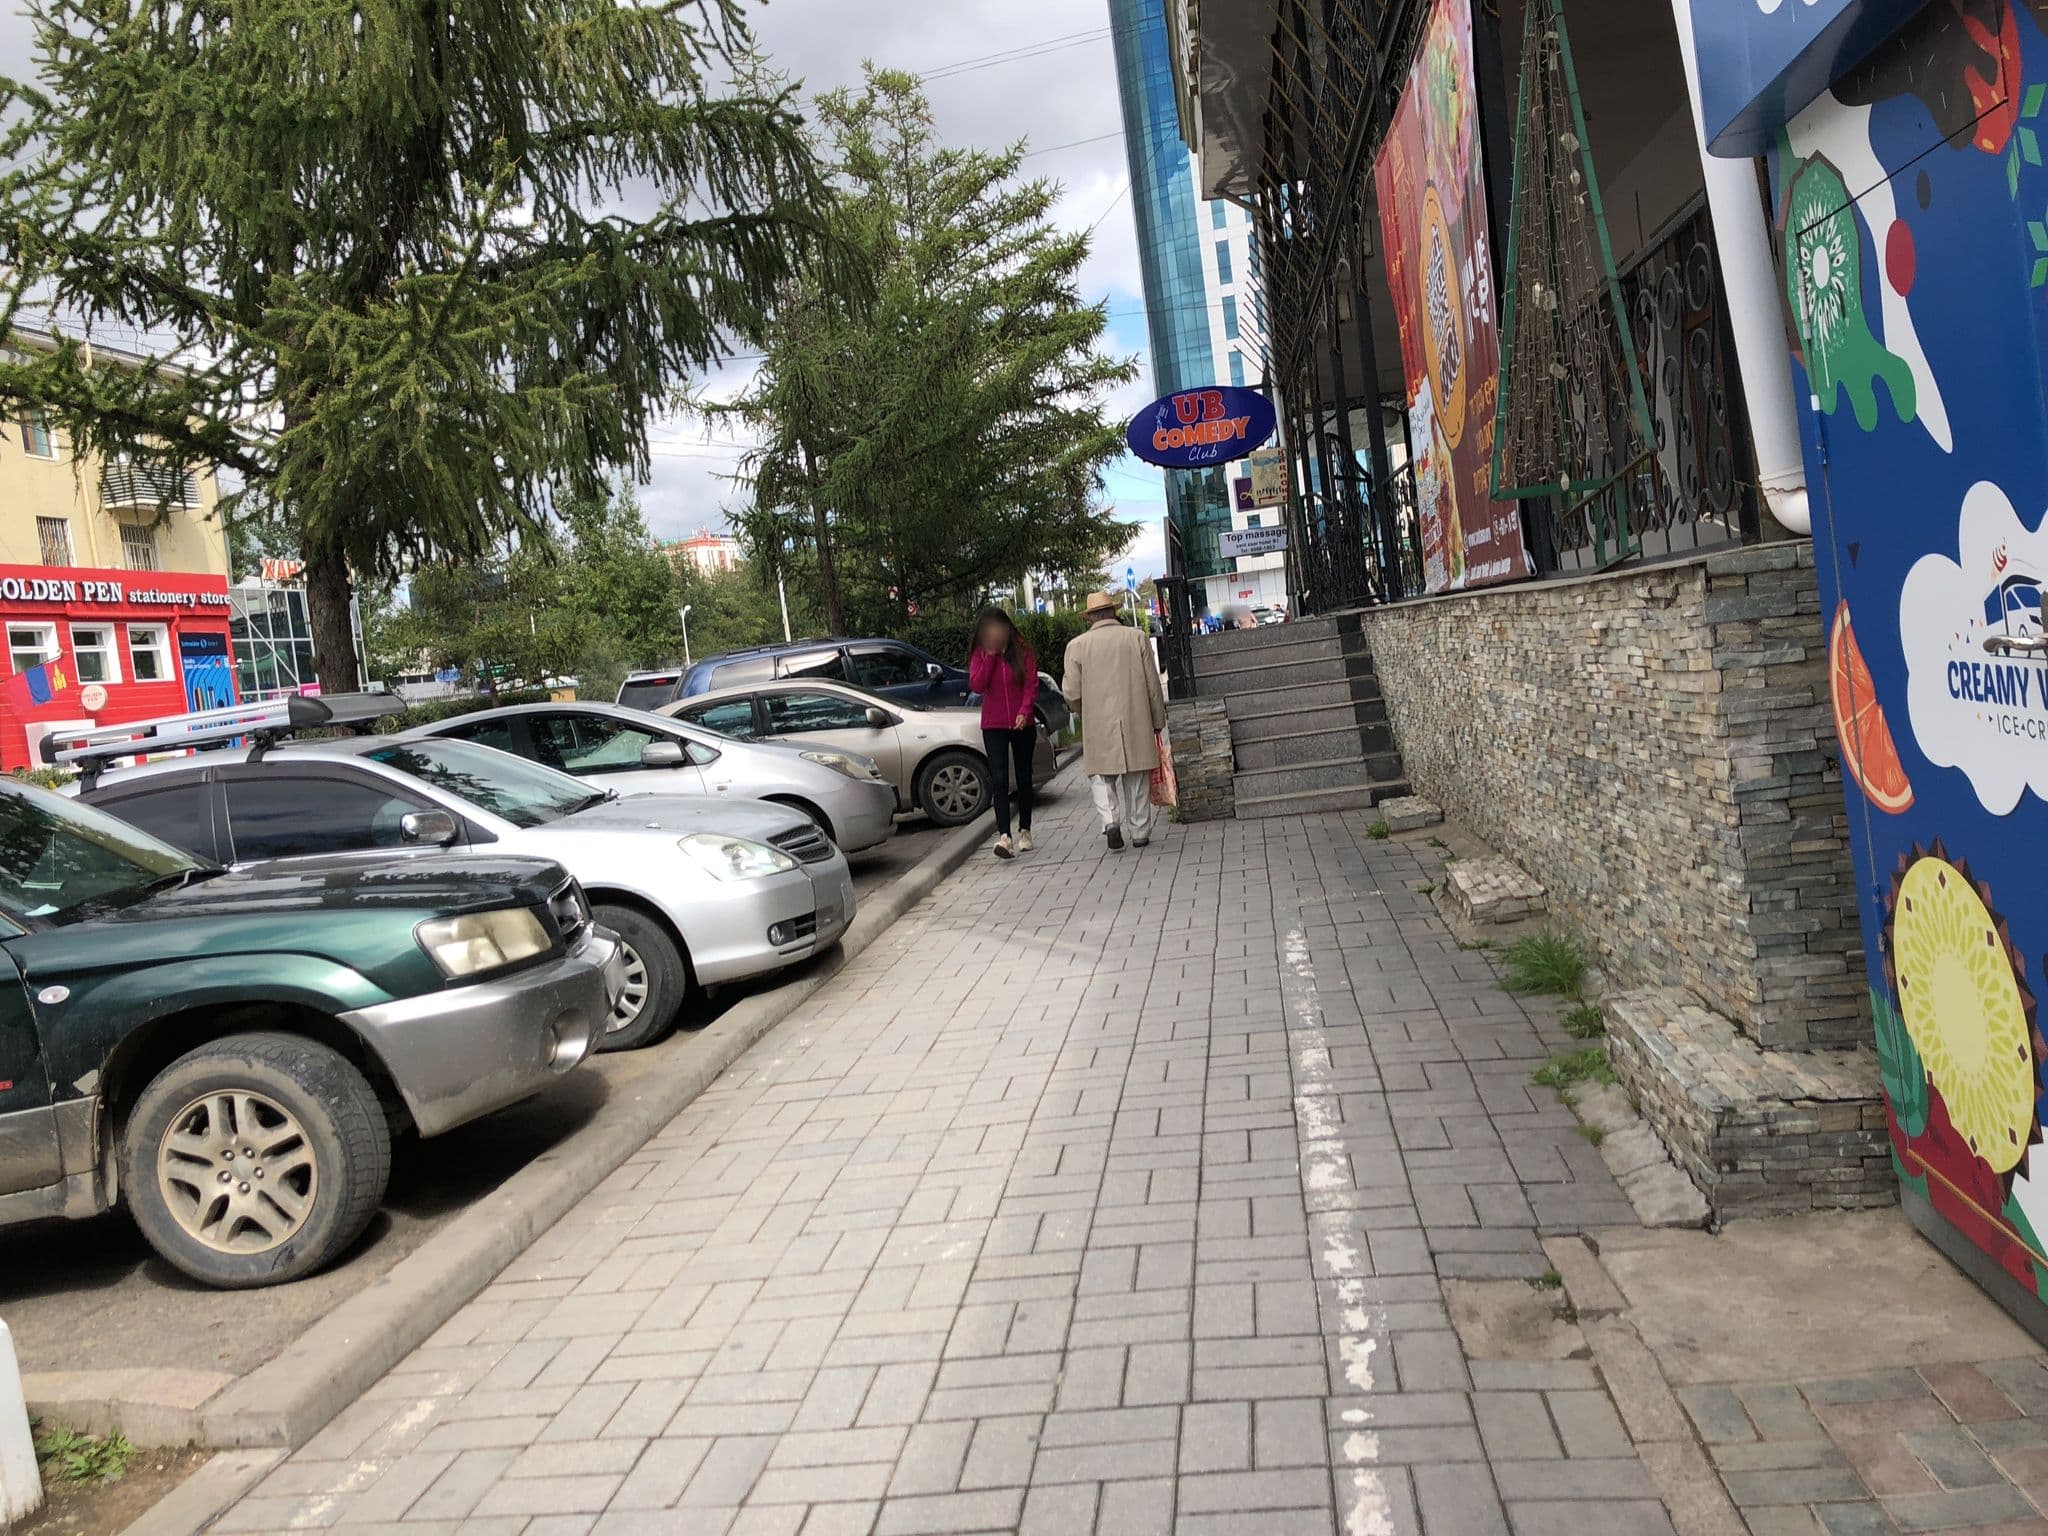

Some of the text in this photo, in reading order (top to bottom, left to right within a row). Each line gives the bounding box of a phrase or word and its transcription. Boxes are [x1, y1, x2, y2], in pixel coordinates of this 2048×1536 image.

[1172, 390, 1225, 424] UB
[1153, 416, 1250, 451] COMEDY
[1188, 444, 1218, 461] Club
[1225, 533, 1243, 543] Top
[0, 577, 231, 608] OLDEN PEN stationery store
[1947, 660, 2029, 708] CREAMY
[1996, 712, 2048, 741] ICE CR
